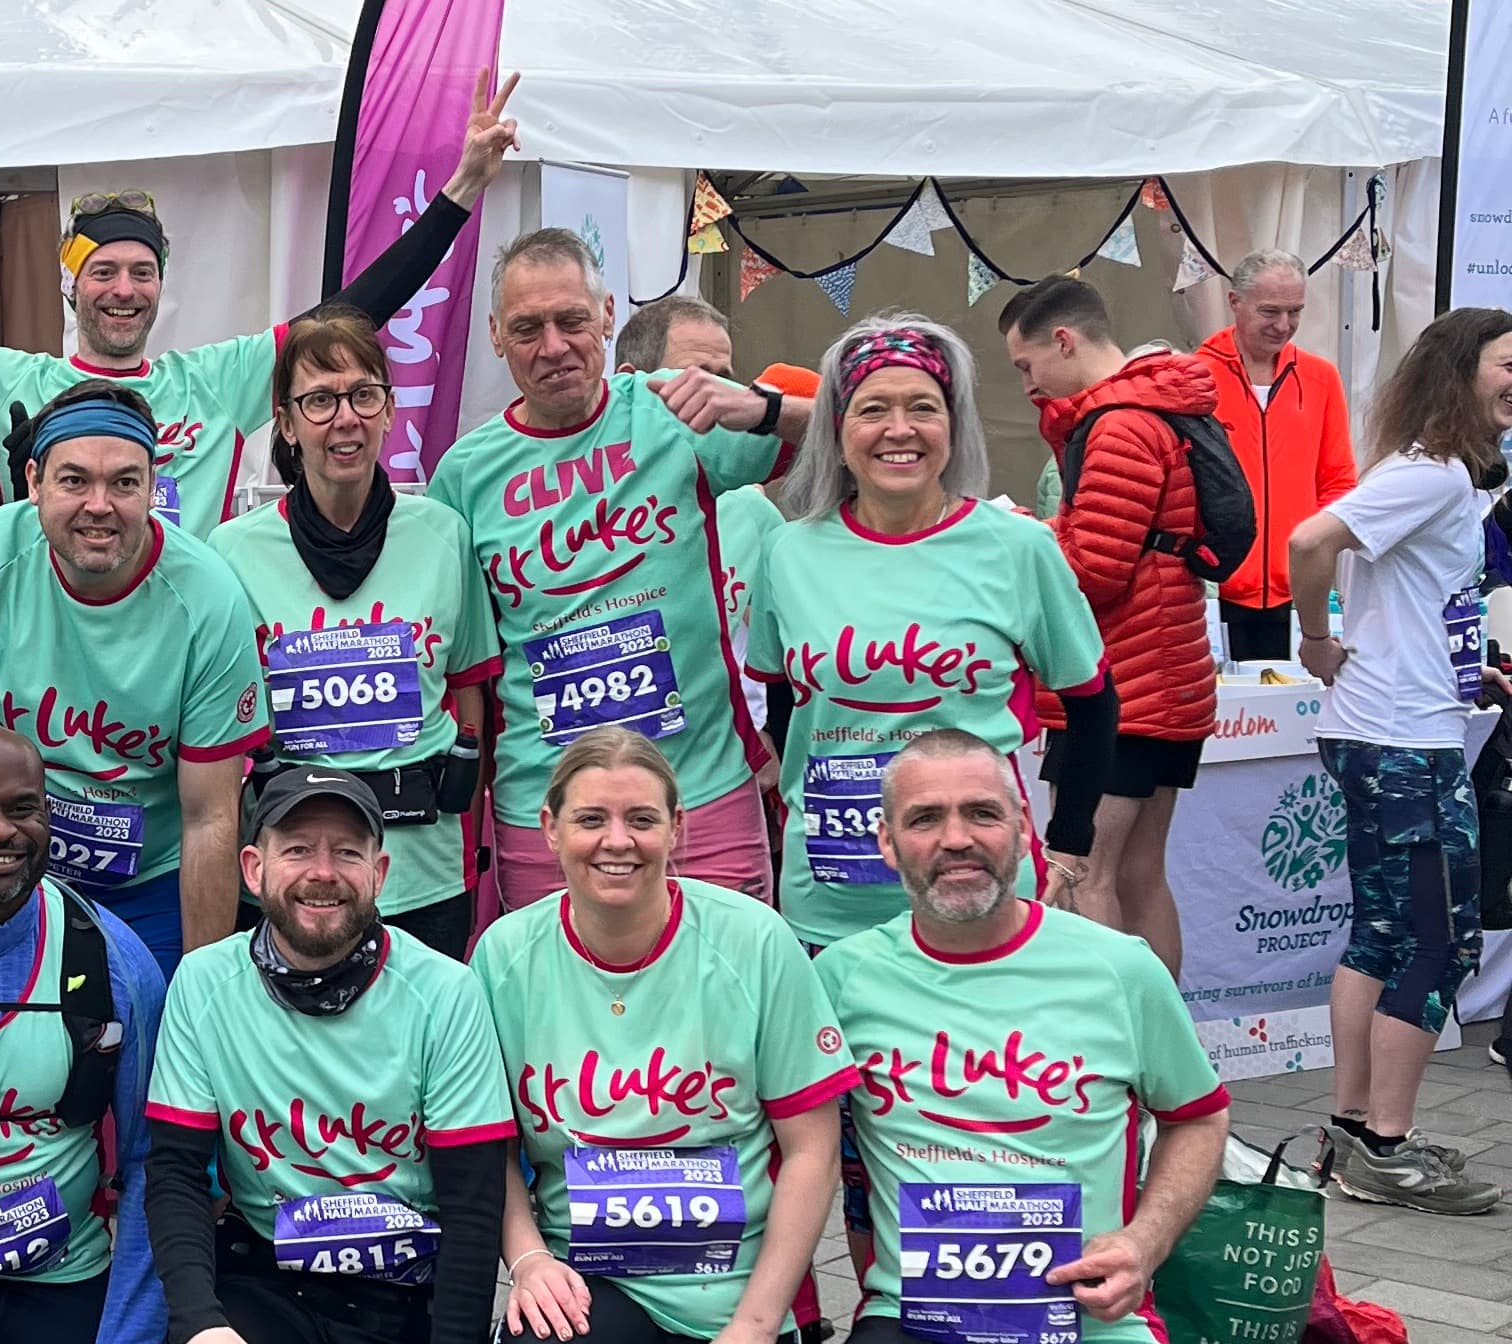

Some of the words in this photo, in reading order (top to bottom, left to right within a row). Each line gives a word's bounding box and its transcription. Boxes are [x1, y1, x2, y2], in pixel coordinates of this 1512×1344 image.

[1489, 108, 1500, 124] A
[502, 441, 636, 518] CLIVE
[540, 495, 679, 573] Luke's
[605, 586, 667, 613] Hospice
[313, 630, 360, 642] SHEFFIELD
[340, 636, 399, 649] MARATHON
[561, 627, 610, 647] SHEFFIELD
[590, 626, 652, 650] MARATHON
[619, 637, 655, 655] 2023
[368, 646, 401, 659] 2023
[834, 622, 992, 697] Luke's
[301, 671, 398, 710] 5068
[560, 664, 658, 712] 4982
[36, 686, 172, 768] Luke's
[69, 811, 131, 828] MARATHON
[825, 806, 885, 838] 538
[95, 826, 130, 840] 2023
[49, 836, 119, 873] 027
[1256, 930, 1332, 953] PROJECT
[1224, 980, 1295, 998] survivors
[1297, 975, 1313, 990] of
[1209, 1047, 1222, 1060] of
[1224, 1043, 1266, 1057] human
[1268, 1032, 1332, 1053] trafficking
[578, 1046, 737, 1121] Luke's
[931, 1030, 1104, 1114] Luke's
[289, 1097, 427, 1163] Luke's
[618, 1151, 674, 1160] SHEFFIELD
[651, 1159, 720, 1170] MARATHON
[895, 1142, 987, 1165] Sheffield's
[991, 1149, 1067, 1169] Hospice
[682, 1169, 723, 1183] 2023
[322, 1196, 376, 1209] SHEFFIELD
[955, 1188, 1015, 1199] SHEFFIELD
[989, 1199, 1063, 1212] MARATHON
[13, 1210, 50, 1232] 2023
[385, 1214, 424, 1229] 2023
[604, 1195, 720, 1228] 5619
[1021, 1212, 1064, 1226] 2023
[1245, 1221, 1300, 1247] THIS
[309, 1238, 417, 1274] 4815
[935, 1241, 1053, 1280] 5679
[1223, 1243, 1278, 1267] NOT
[1039, 1332, 1078, 1344] 5679
[1229, 1317, 1280, 1341] THIS
